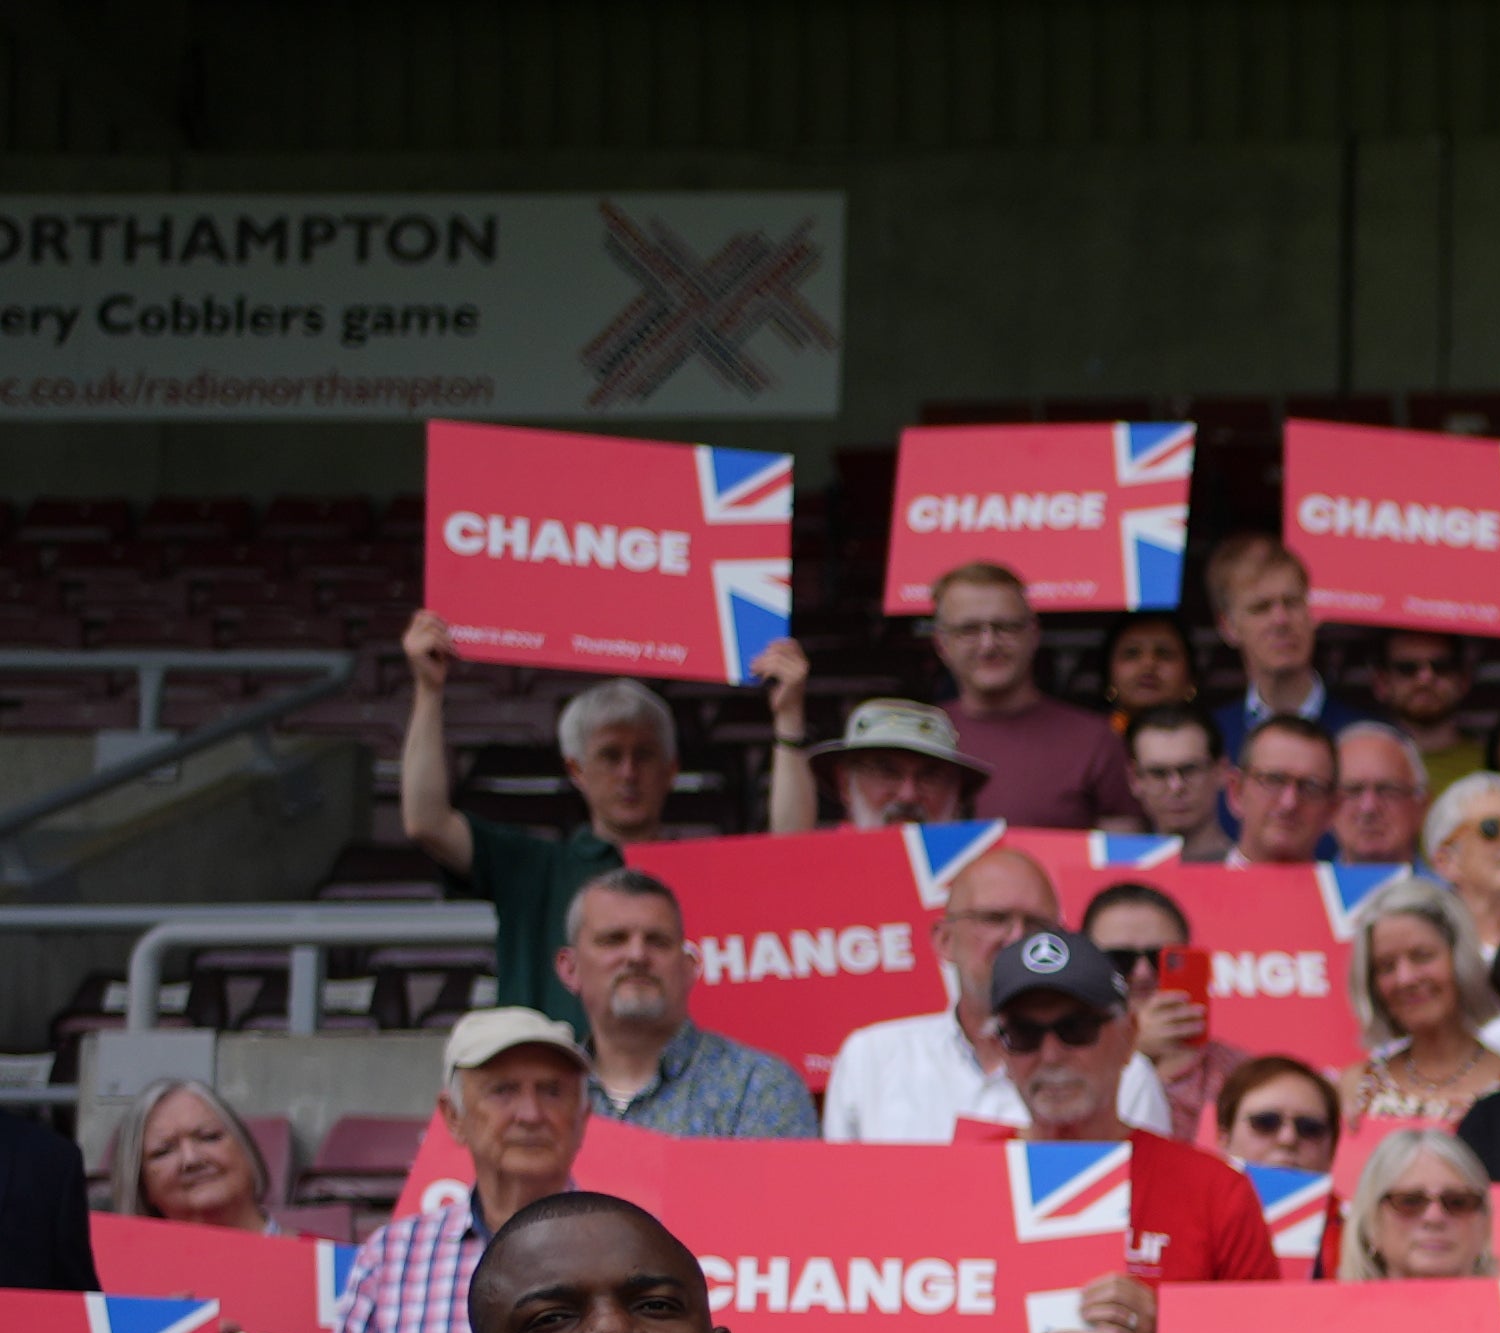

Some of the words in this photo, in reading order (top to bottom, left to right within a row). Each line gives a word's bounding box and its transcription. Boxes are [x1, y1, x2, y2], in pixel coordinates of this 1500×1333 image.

[96, 292, 324, 337] Cobblers
[341, 303, 480, 349] game
[908, 492, 1105, 533] CHANGE
[444, 511, 691, 576] CHANGE
[684, 923, 914, 985] HANGE
